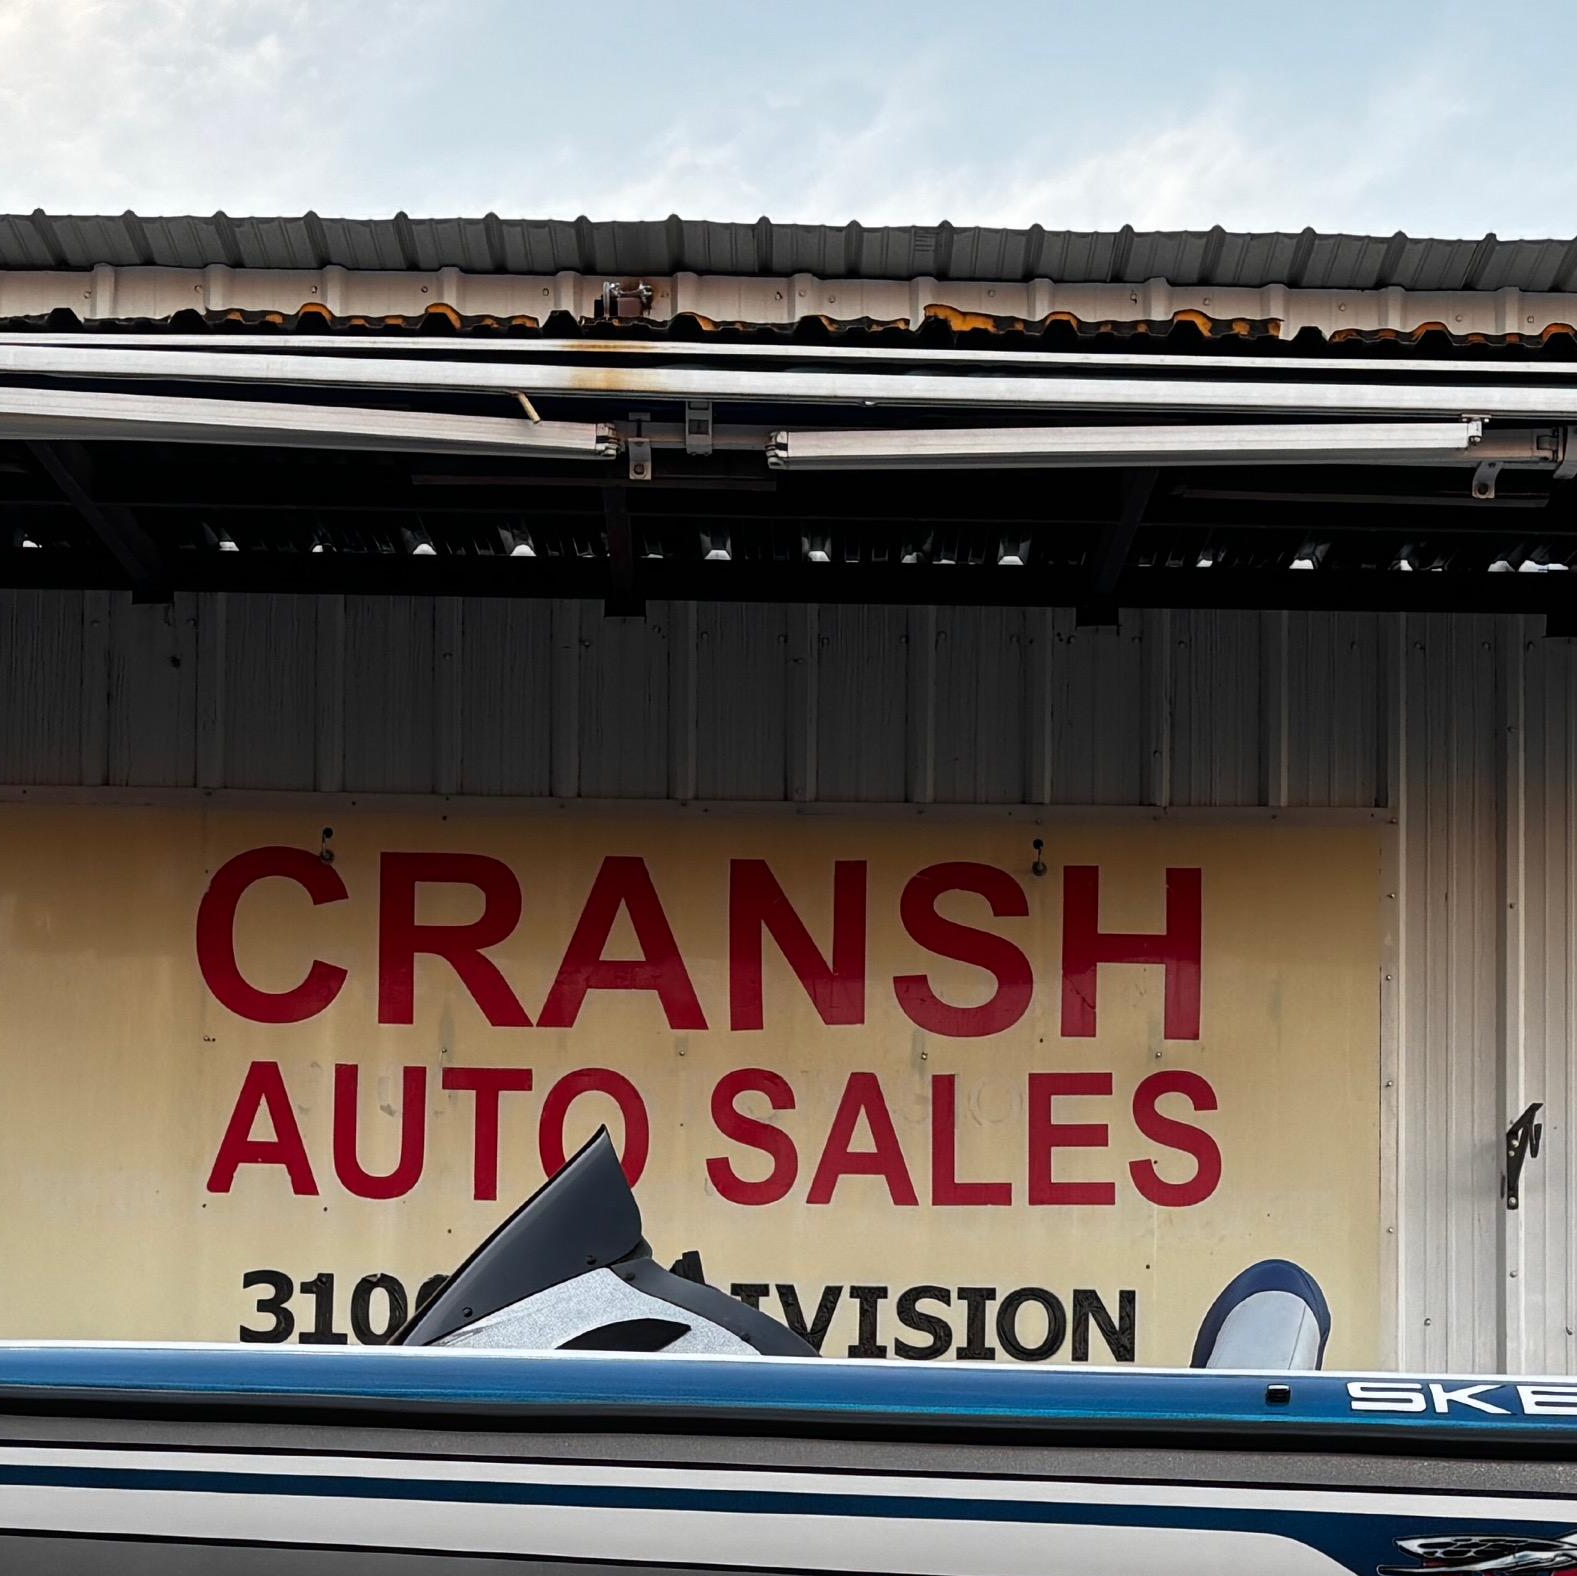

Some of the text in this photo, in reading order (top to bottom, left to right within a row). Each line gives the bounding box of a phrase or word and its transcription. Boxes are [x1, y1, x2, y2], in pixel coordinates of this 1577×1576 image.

[195, 845, 1203, 1041] CRANSH
[206, 1060, 1223, 1208] AUTO SALES
[238, 1268, 452, 1347] 310
